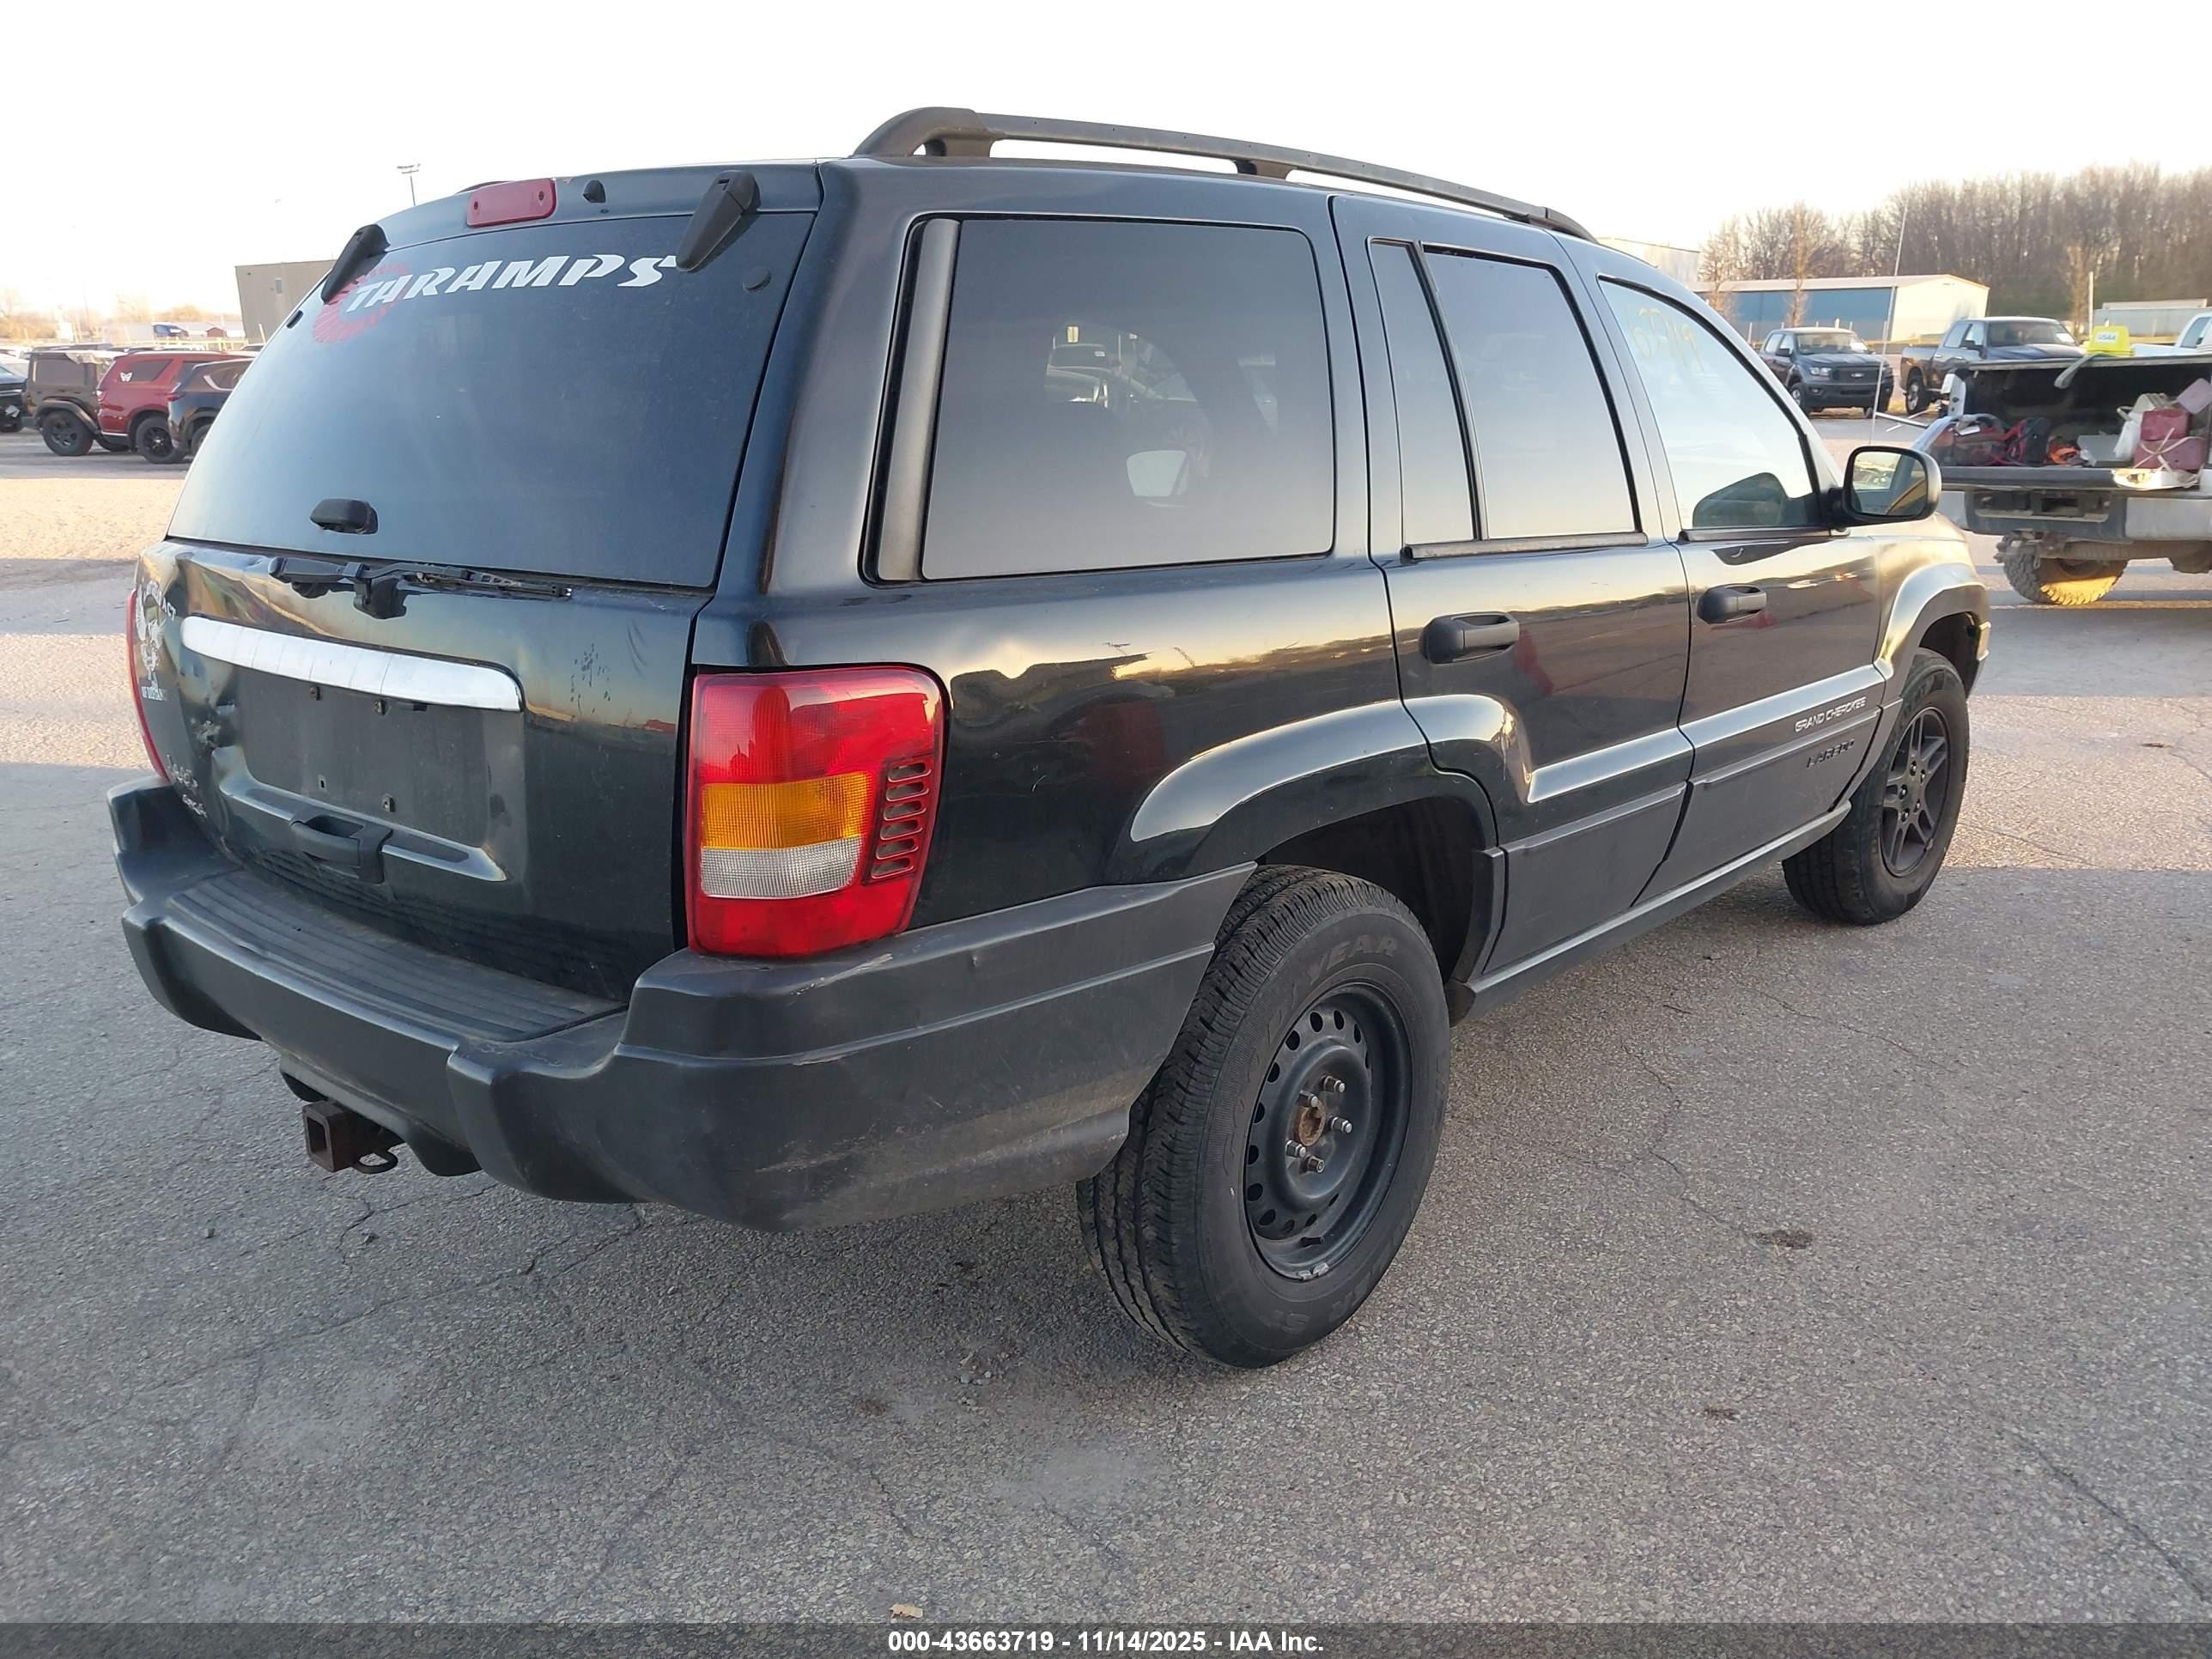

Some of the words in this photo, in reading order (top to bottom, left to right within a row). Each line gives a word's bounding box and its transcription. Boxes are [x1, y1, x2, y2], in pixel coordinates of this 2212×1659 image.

[346, 254, 678, 313] TARAMPS
[1795, 712, 1826, 732] GRAND
[1826, 696, 1868, 720] CHEROKEE
